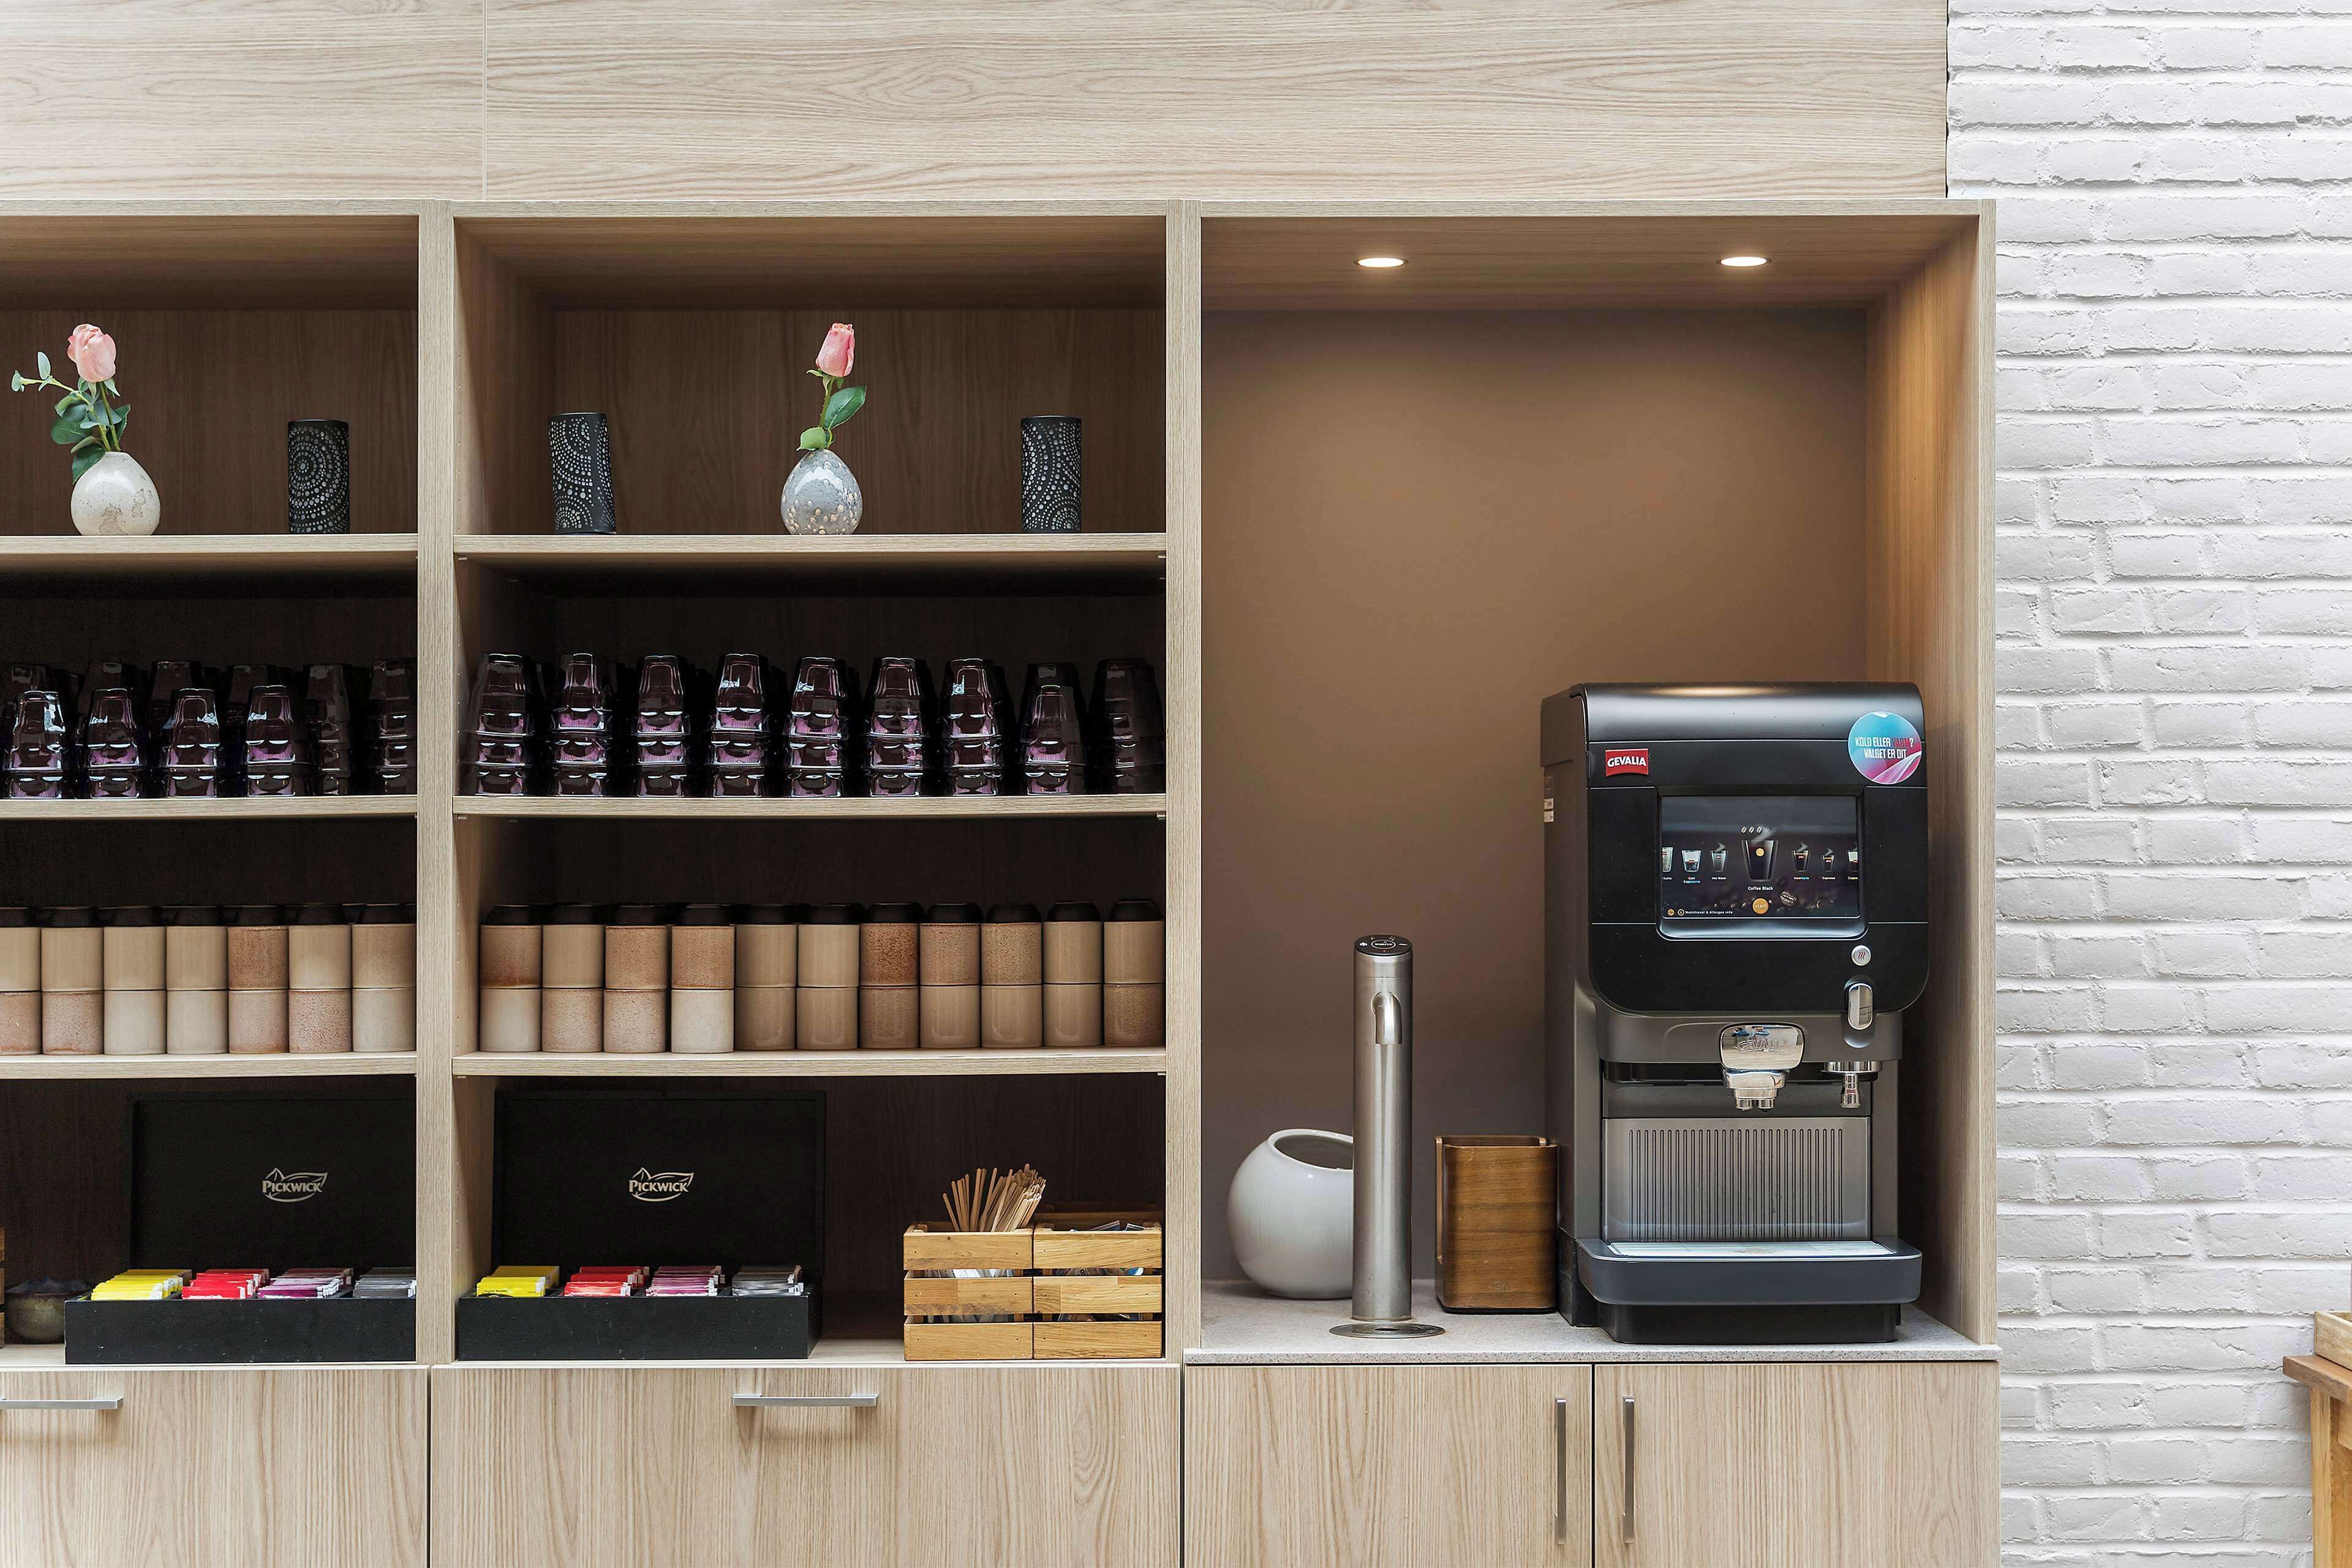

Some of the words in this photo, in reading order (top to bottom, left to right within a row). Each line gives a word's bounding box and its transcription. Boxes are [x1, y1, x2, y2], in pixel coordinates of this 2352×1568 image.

[1855, 737, 1872, 747] KOLD
[1874, 737, 1891, 747] ELLER
[1892, 737, 1914, 748] VARM?
[1864, 748, 1886, 758] VALGET
[1887, 748, 1896, 759] ER
[1897, 749, 1907, 759] DIT
[1607, 756, 1647, 767] GEVALIA
[1738, 1039, 1788, 1052] GEVALIA
[262, 1180, 323, 1193] PICKWICK
[629, 1180, 688, 1193] PICKWICK
